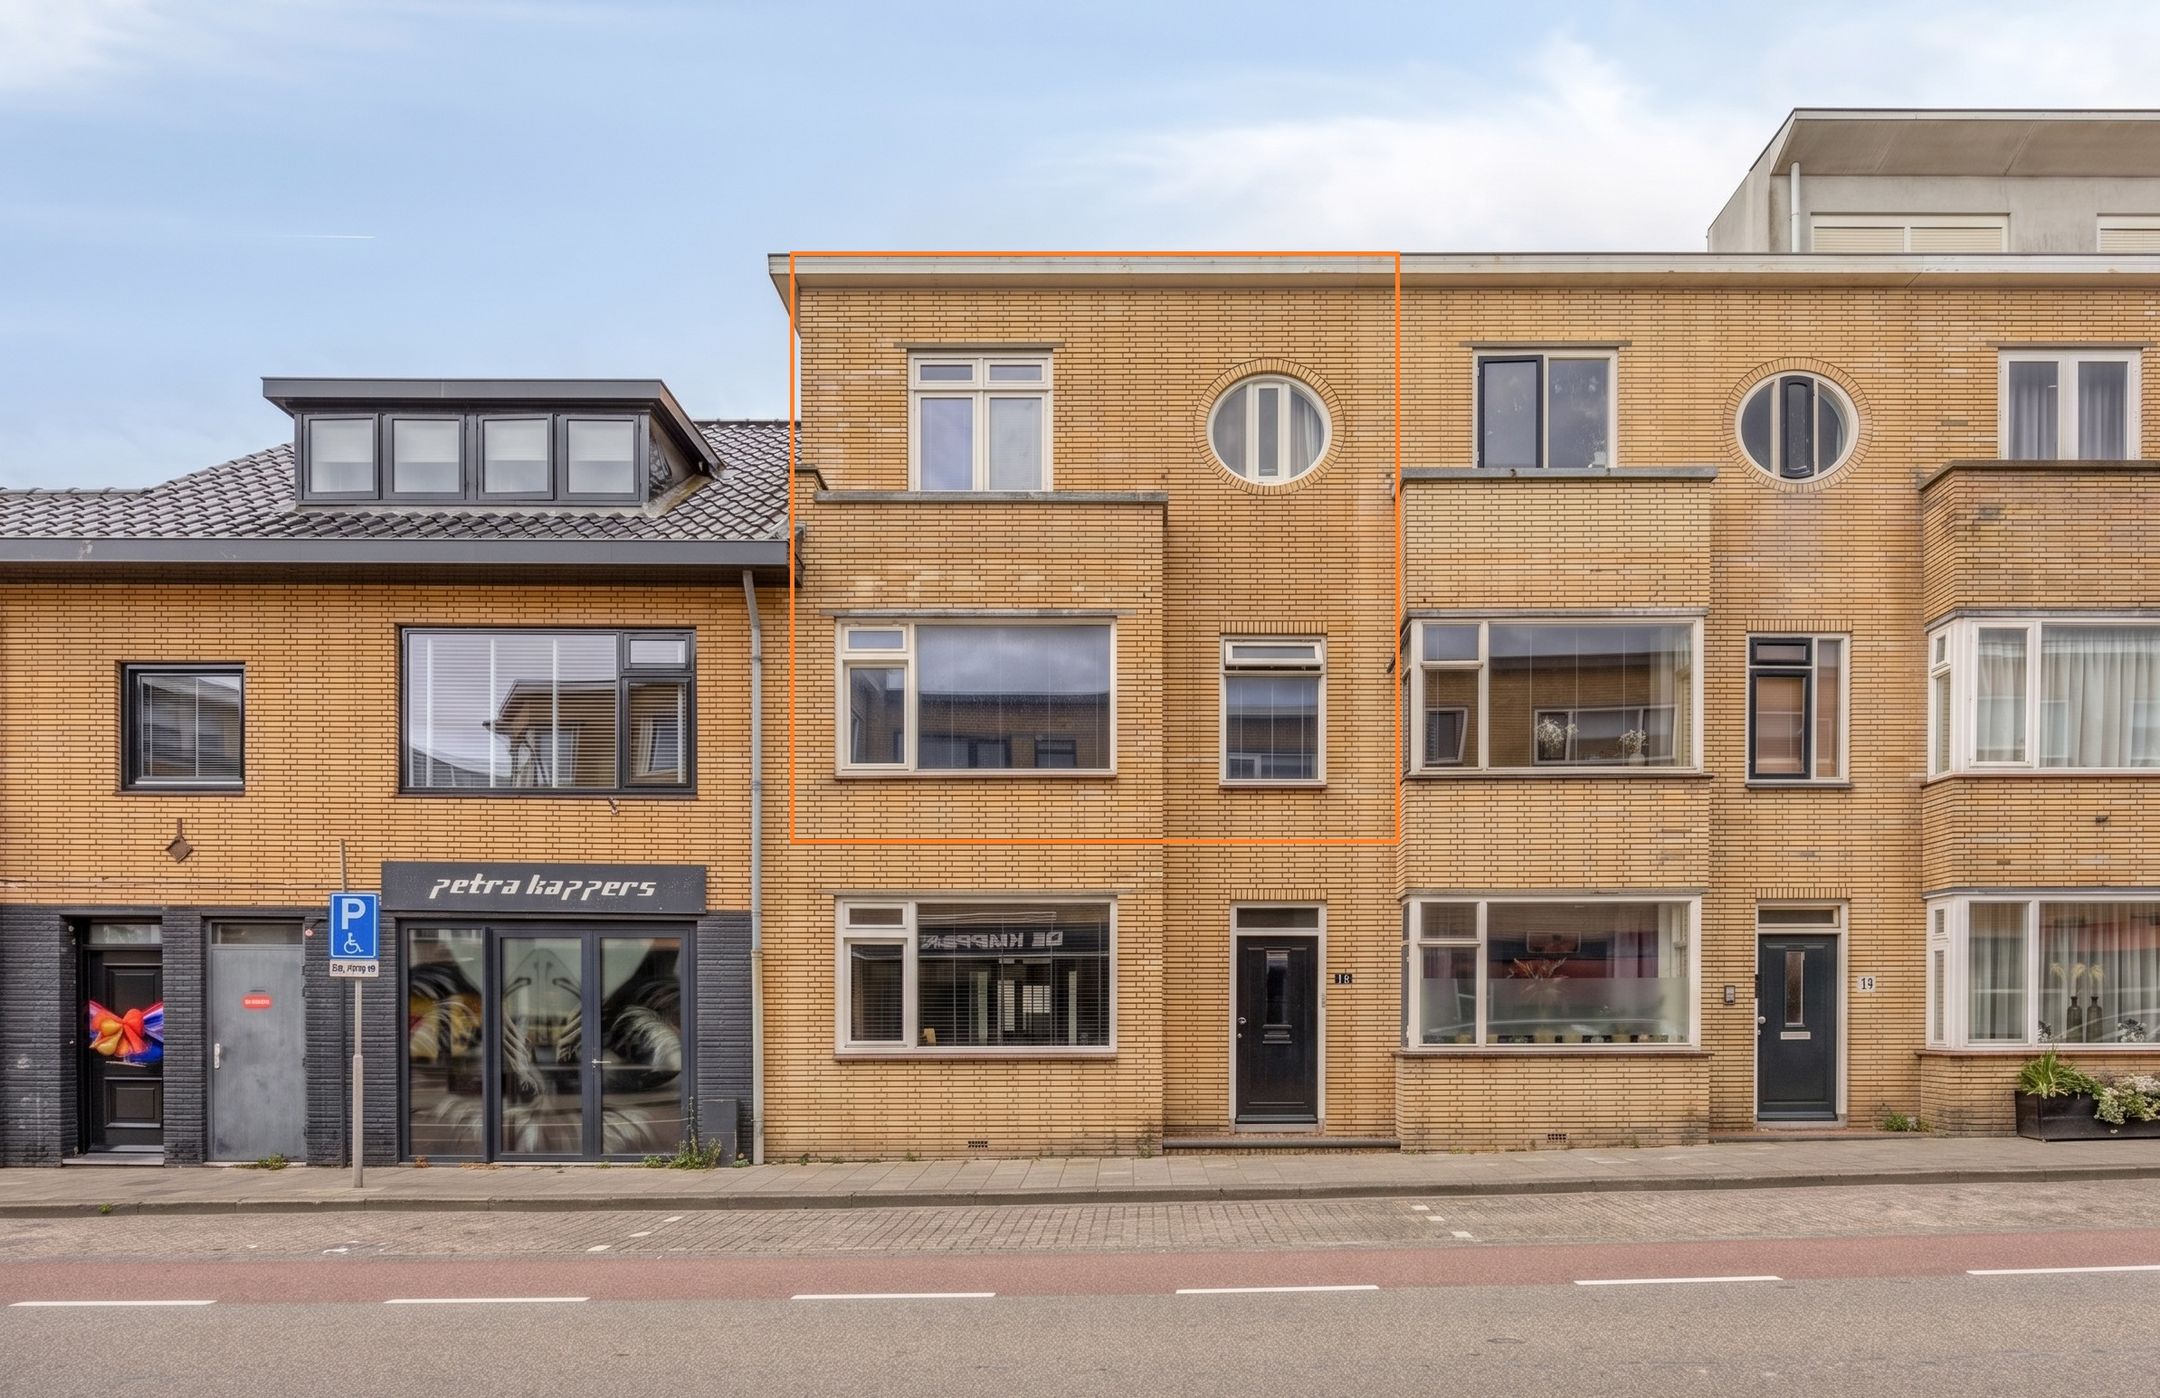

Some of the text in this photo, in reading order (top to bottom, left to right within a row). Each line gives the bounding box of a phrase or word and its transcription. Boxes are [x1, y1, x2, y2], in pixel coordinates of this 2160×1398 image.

[429, 873, 657, 901] petra kappers
[341, 898, 366, 930] P
